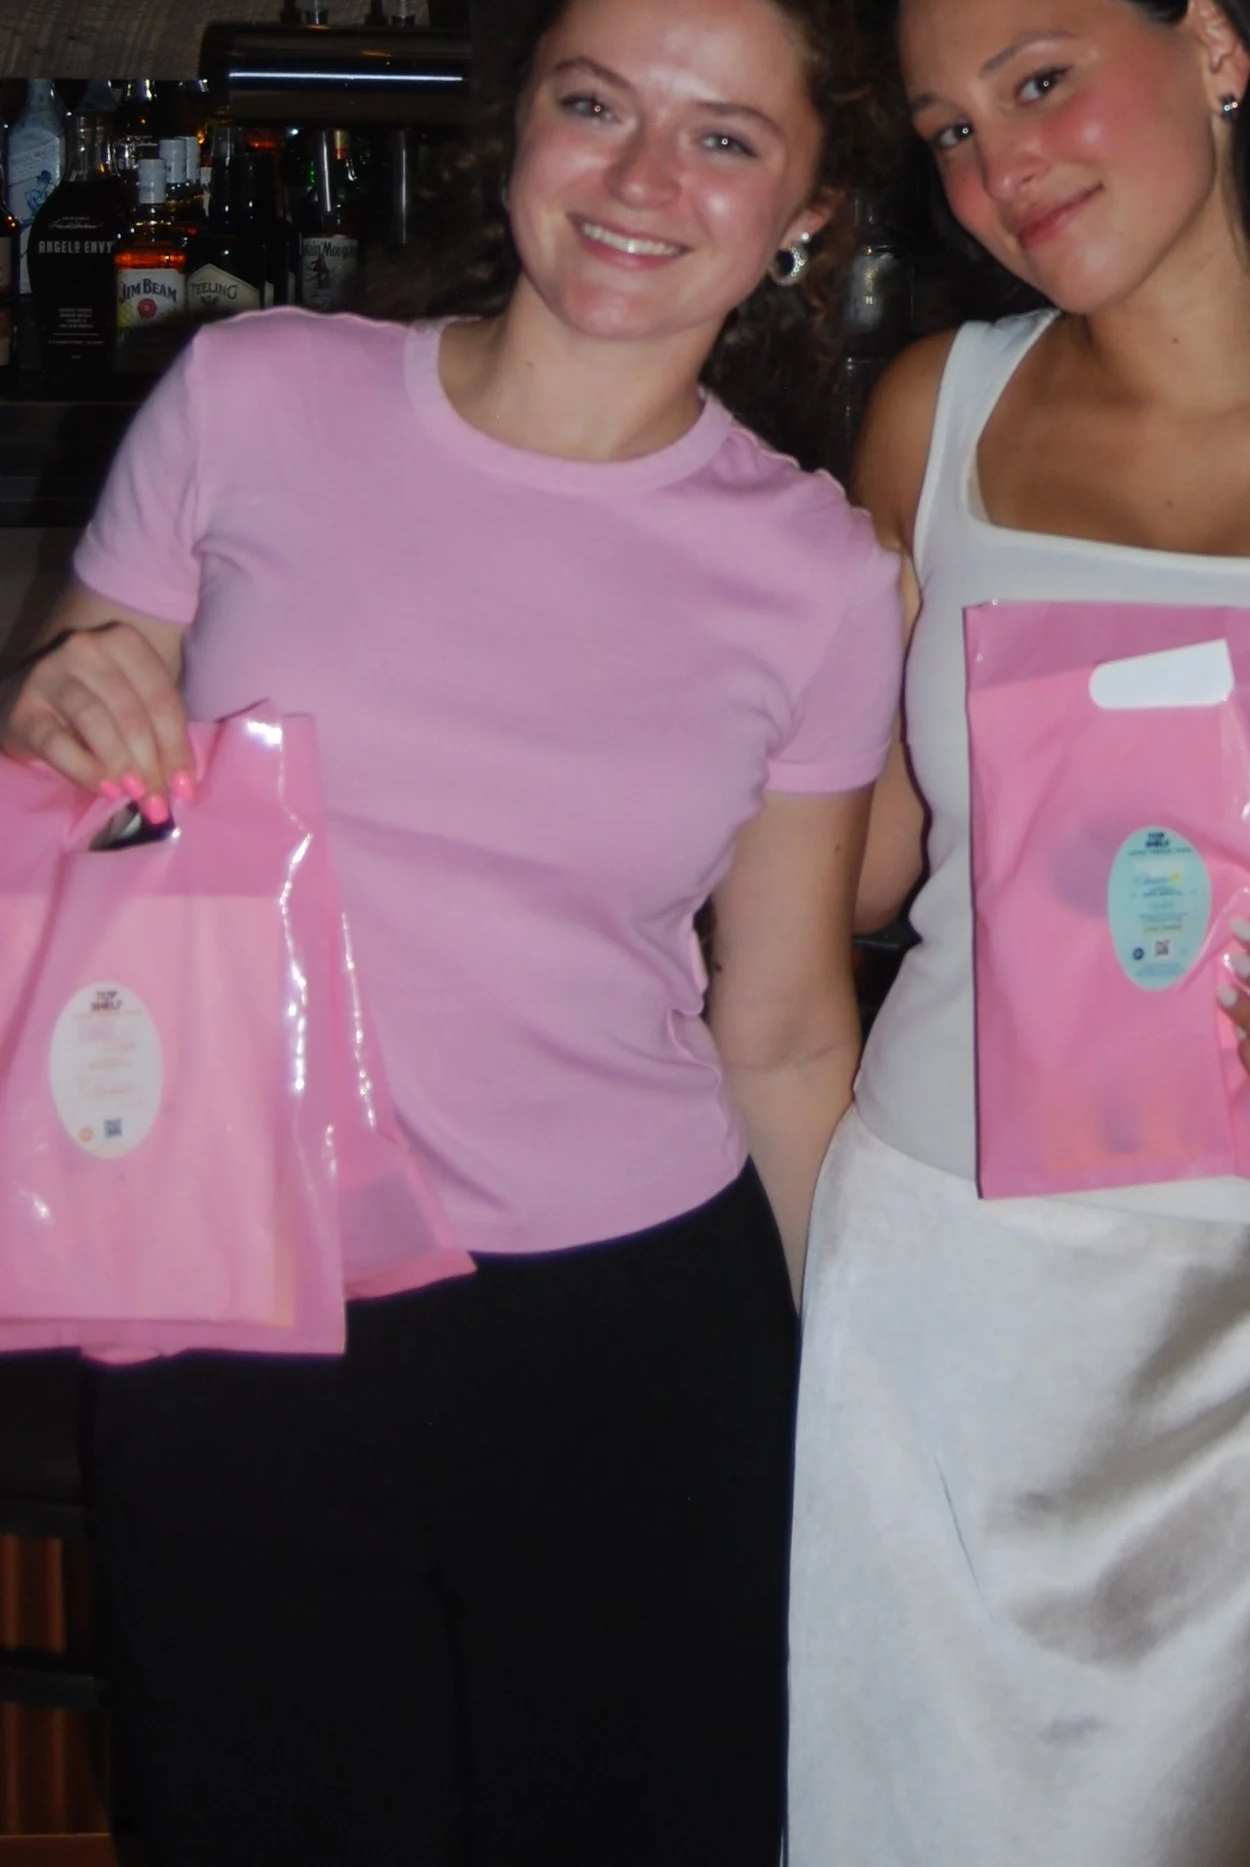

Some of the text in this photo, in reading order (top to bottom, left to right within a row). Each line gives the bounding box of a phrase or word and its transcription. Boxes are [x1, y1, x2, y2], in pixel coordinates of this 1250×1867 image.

[84, 240, 114, 254] ENVY
[120, 277, 177, 303] JIM BEAM
[190, 282, 237, 300] TEELING
